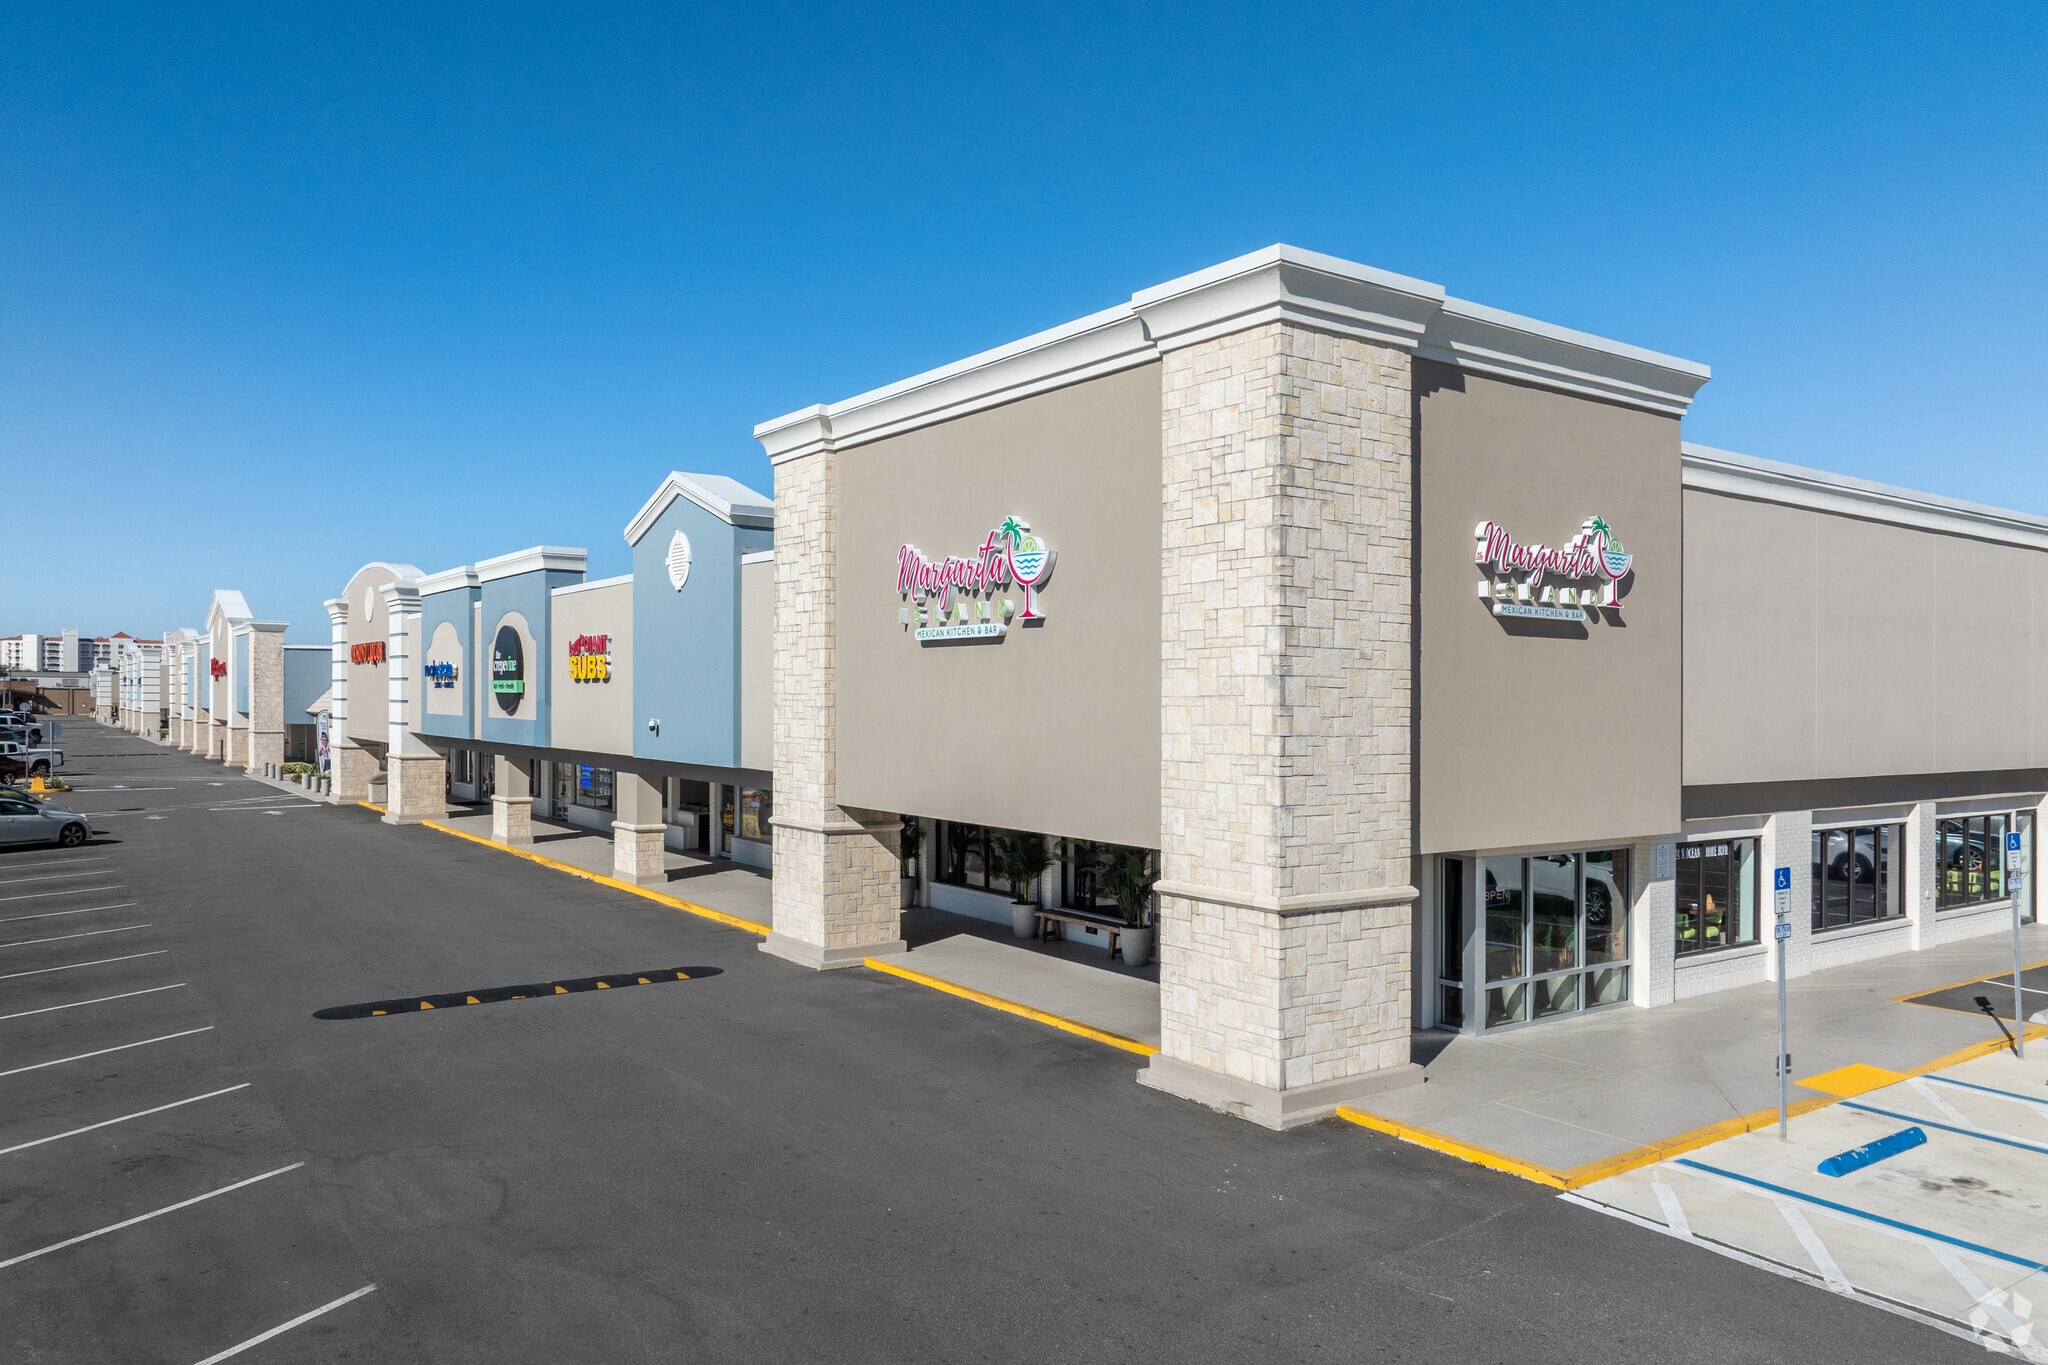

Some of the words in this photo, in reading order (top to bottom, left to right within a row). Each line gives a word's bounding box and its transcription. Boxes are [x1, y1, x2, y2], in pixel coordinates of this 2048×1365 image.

[1484, 521, 1600, 588] Margarita
[898, 530, 1007, 611] Margarita
[1484, 581, 1598, 605] ISLAND
[899, 598, 1009, 624] ISLAND
[1502, 606, 1532, 615] MEXICAN
[1534, 608, 1562, 617] KITCHEN
[1572, 612, 1584, 620] BAR
[584, 634, 608, 652] GIANT
[916, 628, 944, 638] MEXICAN
[945, 624, 974, 636] KITCHEN
[977, 626, 982, 634] &
[984, 625, 998, 634] BAR
[569, 655, 607, 679] SUBS
